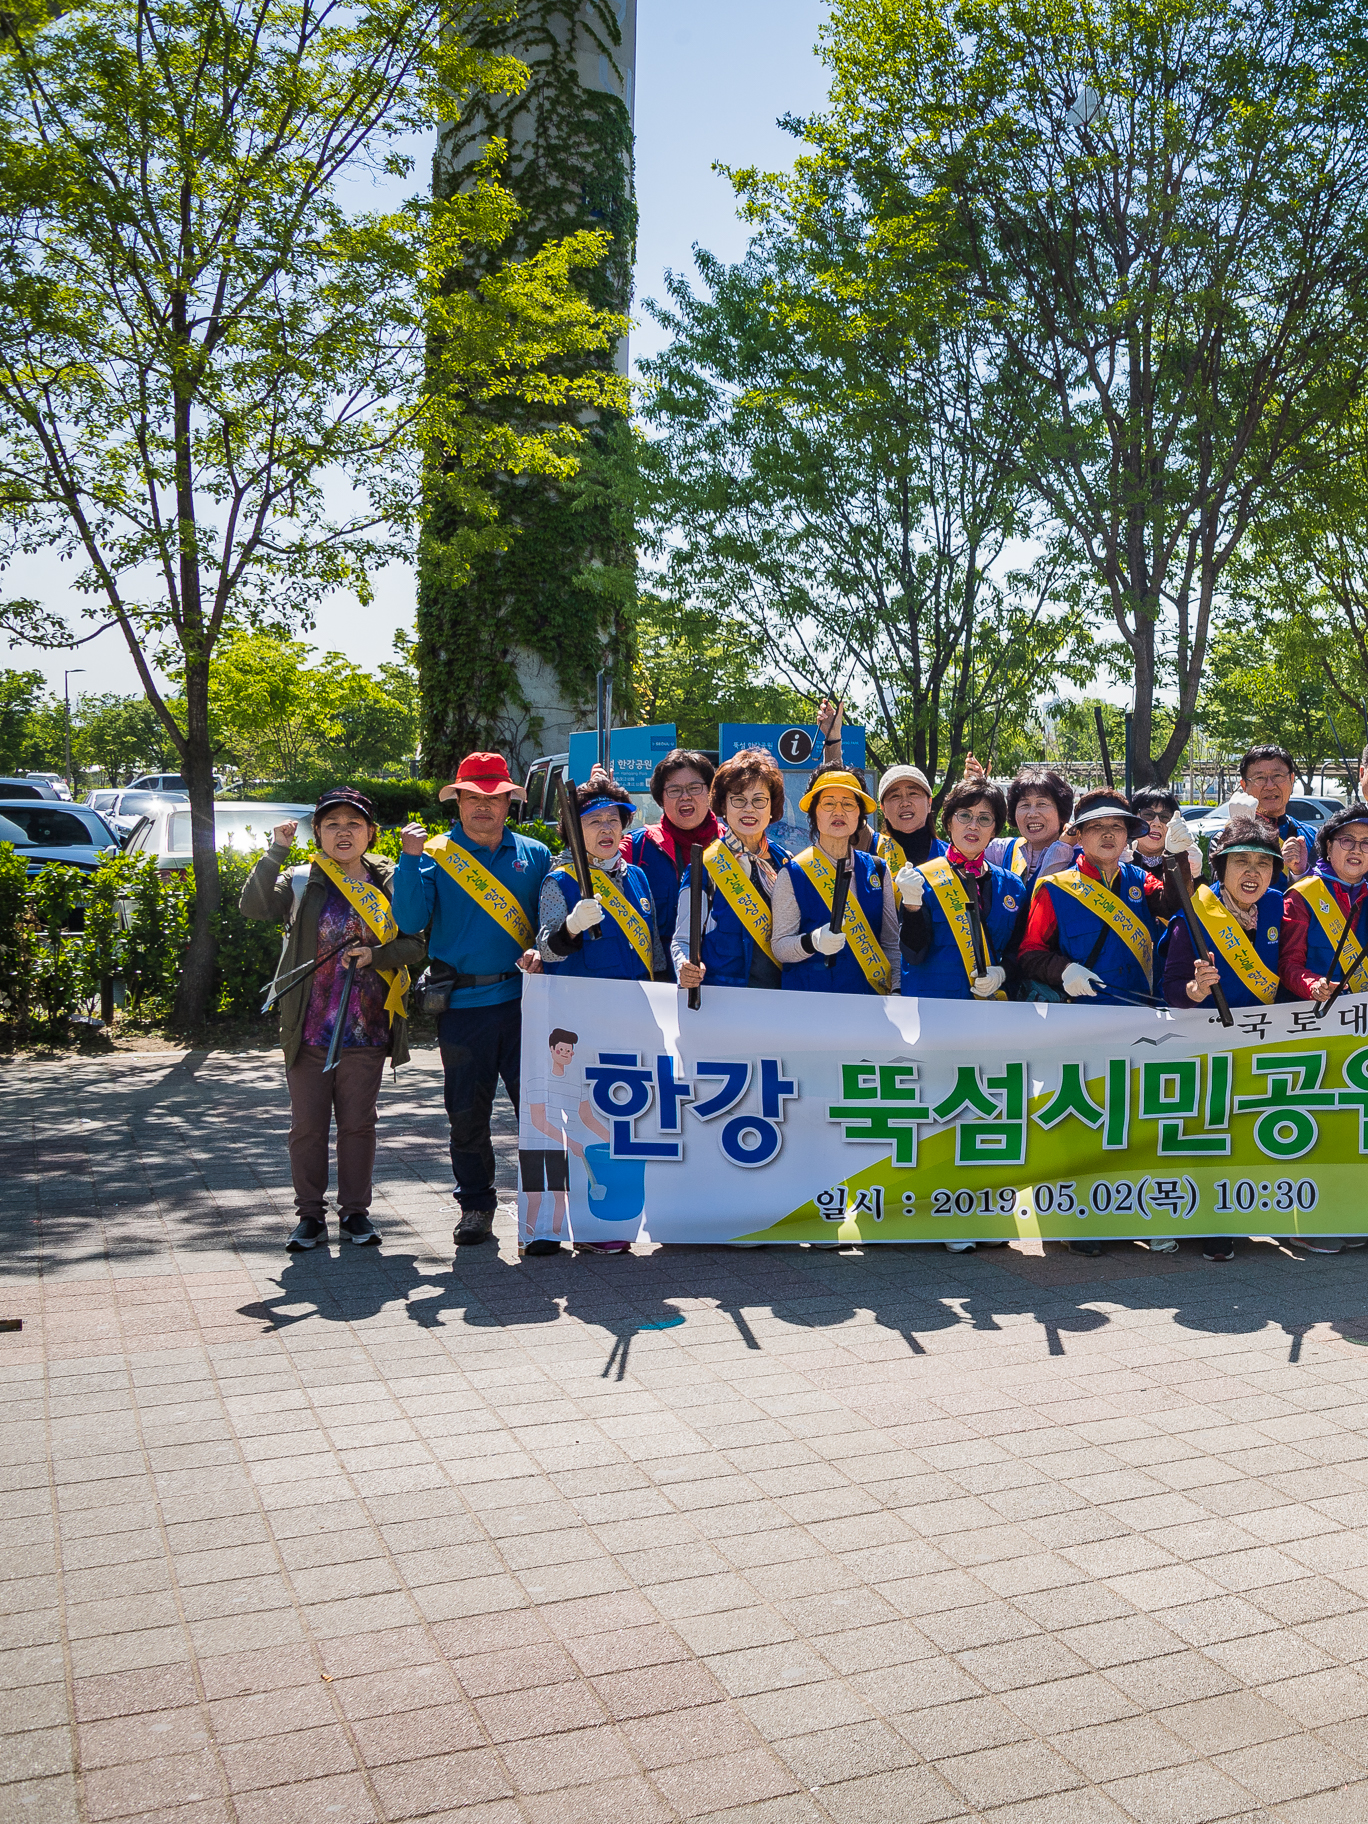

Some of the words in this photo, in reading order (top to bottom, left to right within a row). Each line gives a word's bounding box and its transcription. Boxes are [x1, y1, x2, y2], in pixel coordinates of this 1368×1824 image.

[617, 759, 653, 770] 한강공원
[446, 852, 470, 874] 강과
[466, 869, 489, 892] 산을
[484, 888, 508, 910] 항상
[609, 896, 628, 917] 항상
[710, 853, 732, 875] 강과
[725, 872, 745, 895] 산을
[737, 893, 759, 916] 항상
[931, 869, 954, 887] 강과
[945, 889, 965, 911] 산을
[806, 857, 830, 878] 강과
[849, 921, 882, 967] 깨끗하게
[1093, 892, 1116, 914] 산을
[1113, 909, 1133, 931] 항상
[1218, 926, 1241, 950] 강과
[1234, 949, 1255, 971] 산을
[1247, 970, 1268, 987] 항상
[585, 1050, 798, 1168] 한강
[814, 1184, 885, 1223] 일시
[931, 1175, 1198, 1220] 2019.05.02(목)
[1214, 1177, 1318, 1214] 10:30
